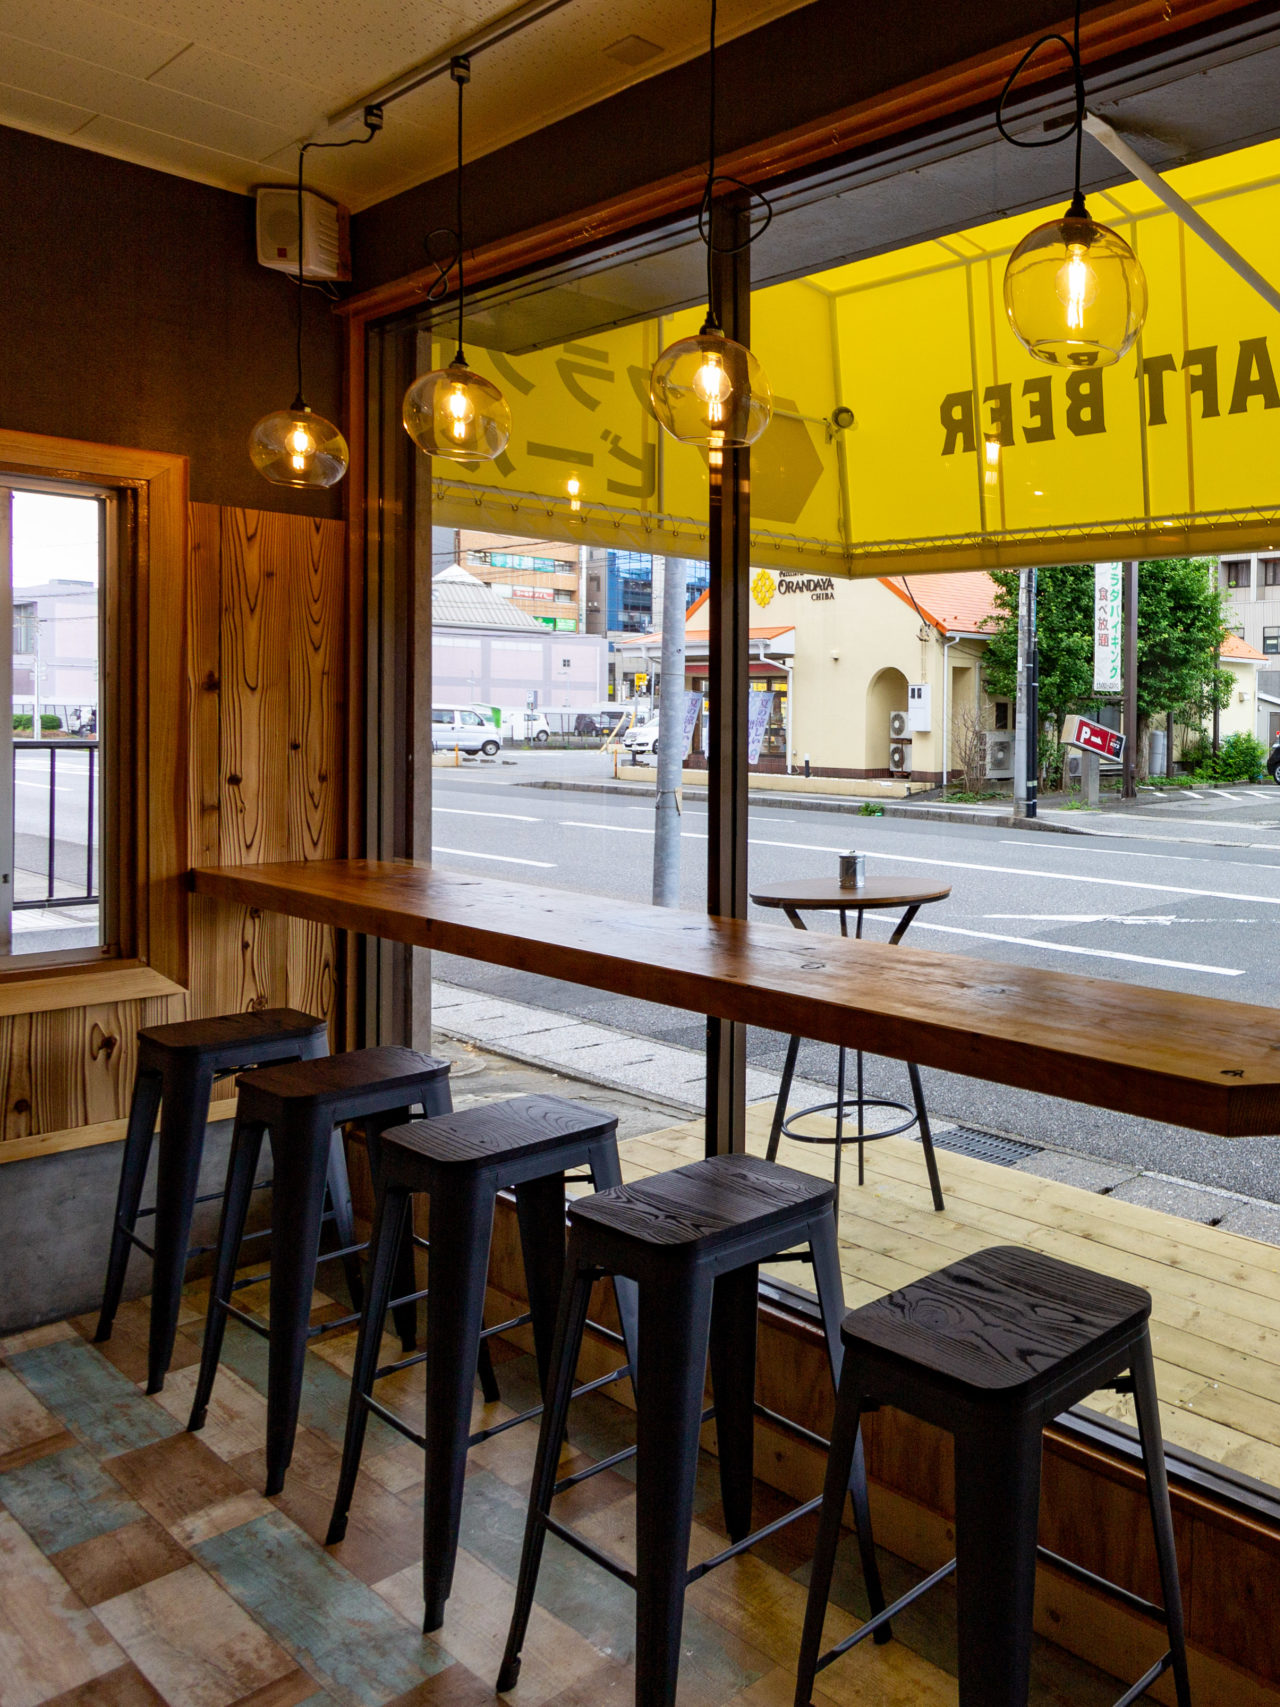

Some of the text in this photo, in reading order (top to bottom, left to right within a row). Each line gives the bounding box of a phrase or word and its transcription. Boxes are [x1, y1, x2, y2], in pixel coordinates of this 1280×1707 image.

[778, 578, 834, 595] ORANDAYA
[811, 593, 834, 602] CHIBA
[1098, 587, 1109, 647] 食べ放題
[1080, 726, 1091, 743] P
